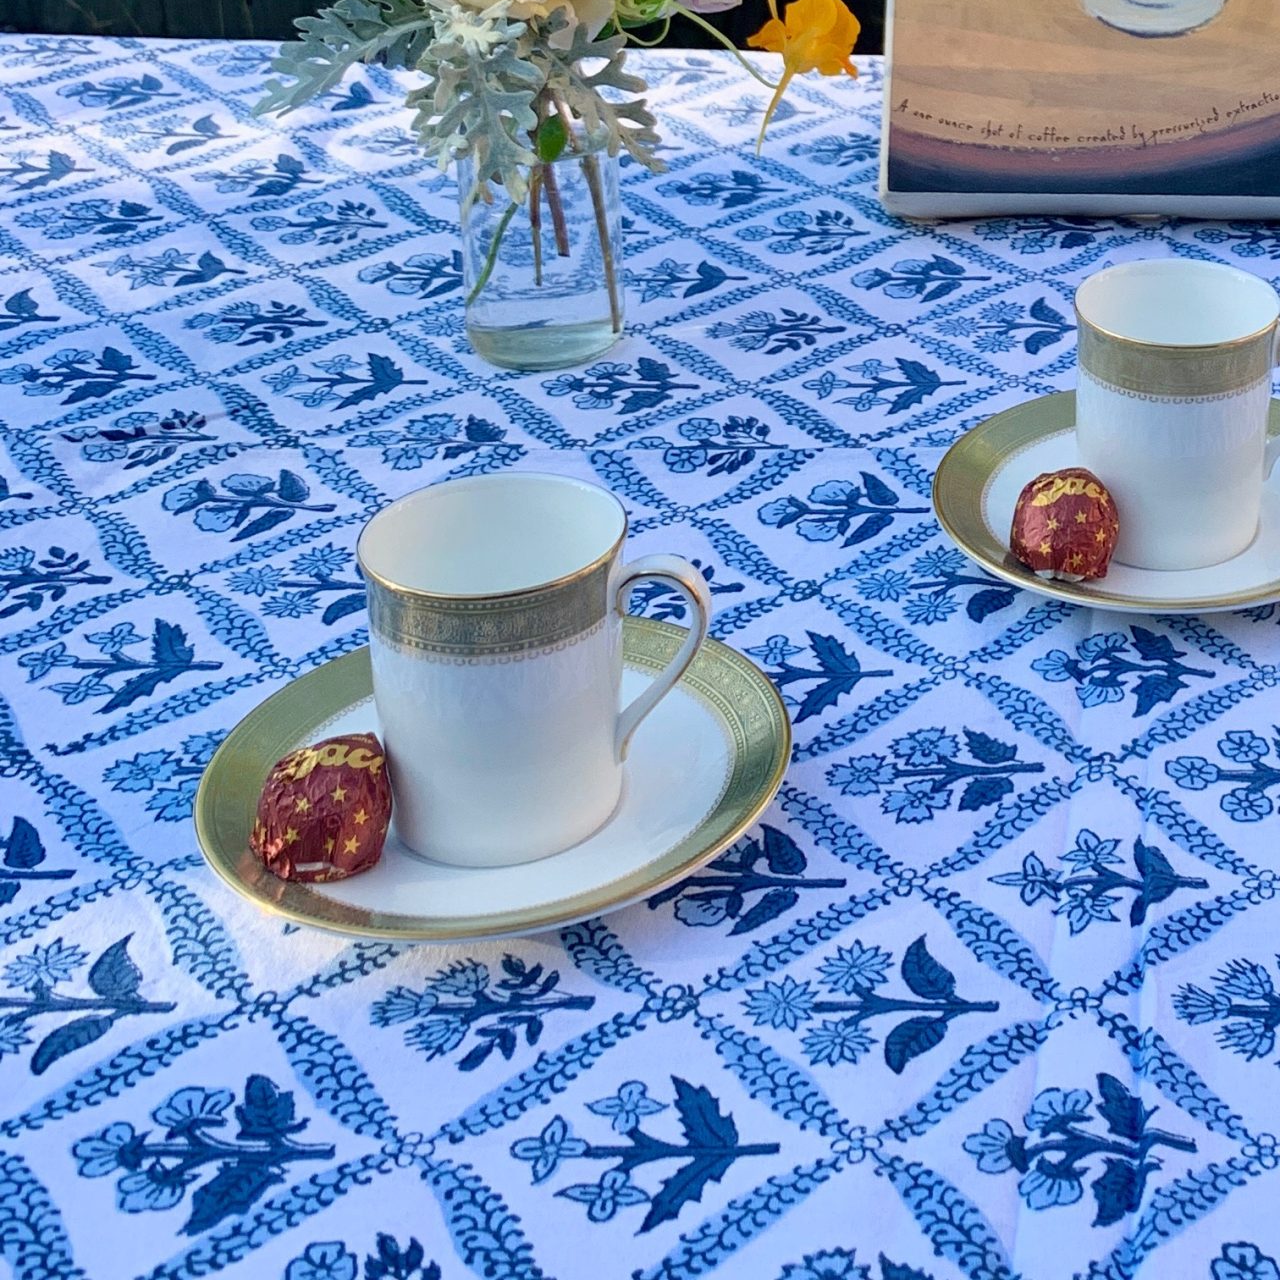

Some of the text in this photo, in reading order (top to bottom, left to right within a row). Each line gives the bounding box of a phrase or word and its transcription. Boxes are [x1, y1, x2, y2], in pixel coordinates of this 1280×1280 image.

[892, 98, 909, 113] A
[912, 110, 933, 121] one
[938, 116, 974, 131] ounce
[980, 119, 1003, 140] shot
[1009, 123, 1023, 140] of
[1028, 126, 1070, 142] coffee
[1077, 125, 1126, 143] created
[1131, 124, 1147, 148] by
